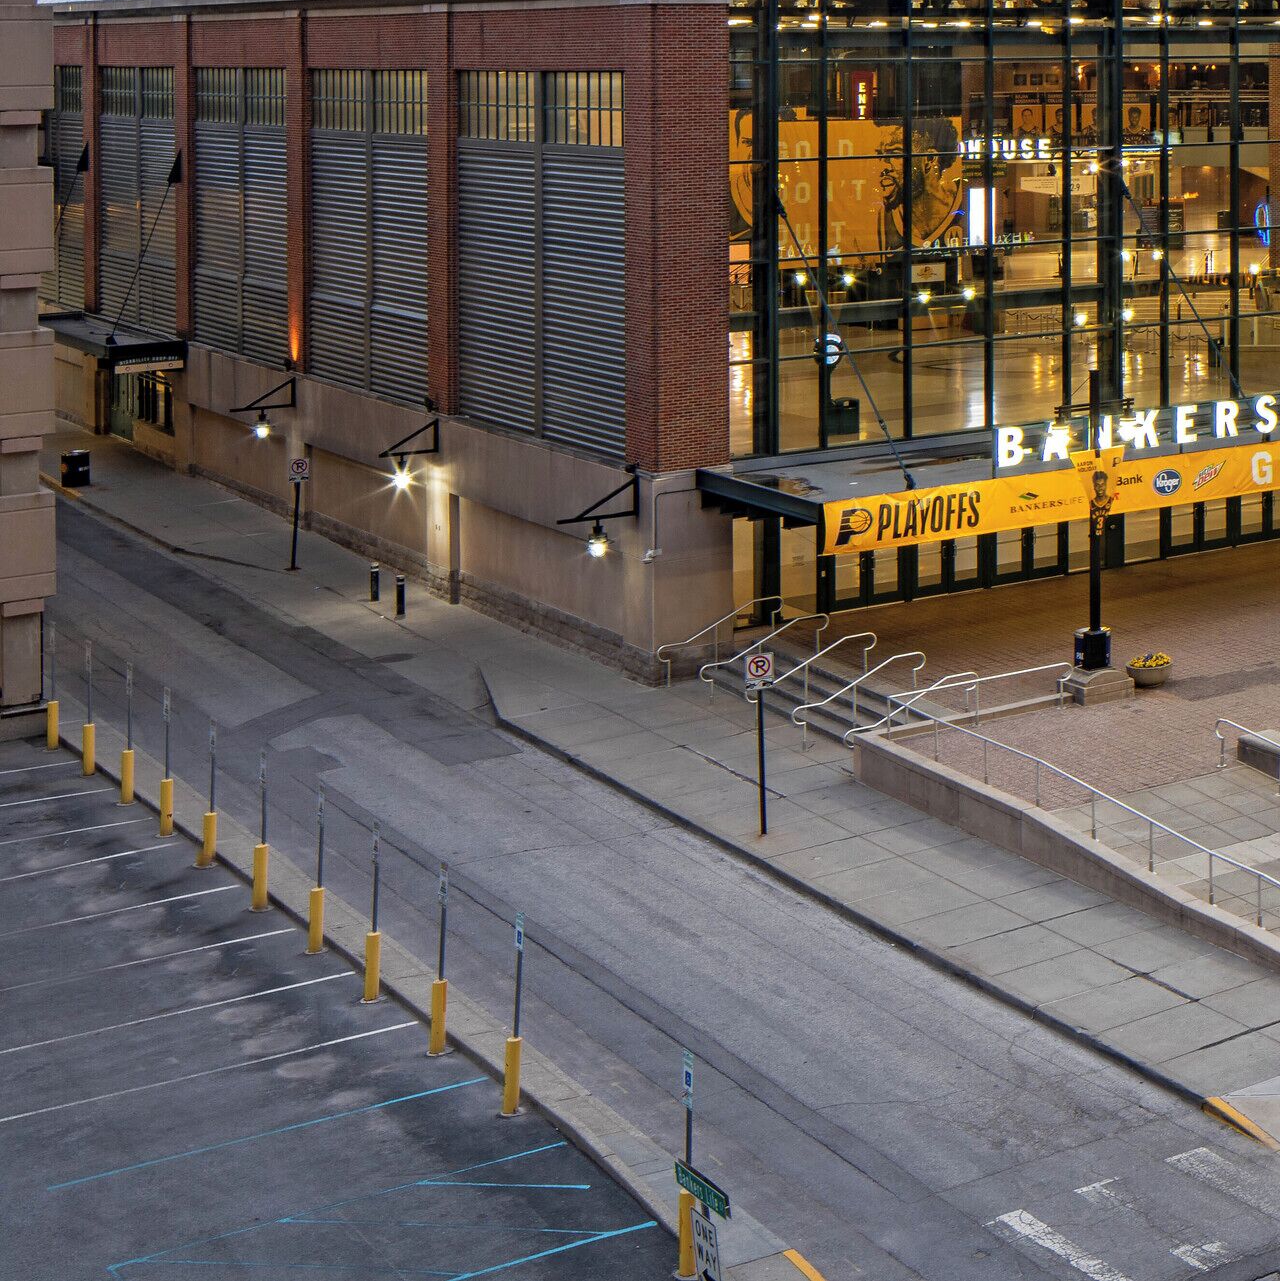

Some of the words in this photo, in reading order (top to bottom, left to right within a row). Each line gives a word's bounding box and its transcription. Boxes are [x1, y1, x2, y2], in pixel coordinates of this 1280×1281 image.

[1156, 473, 1180, 492] Kroger
[876, 490, 981, 541] PLAYOFFS
[695, 1219, 715, 1249] ONE
[698, 1242, 717, 1270] WAY
